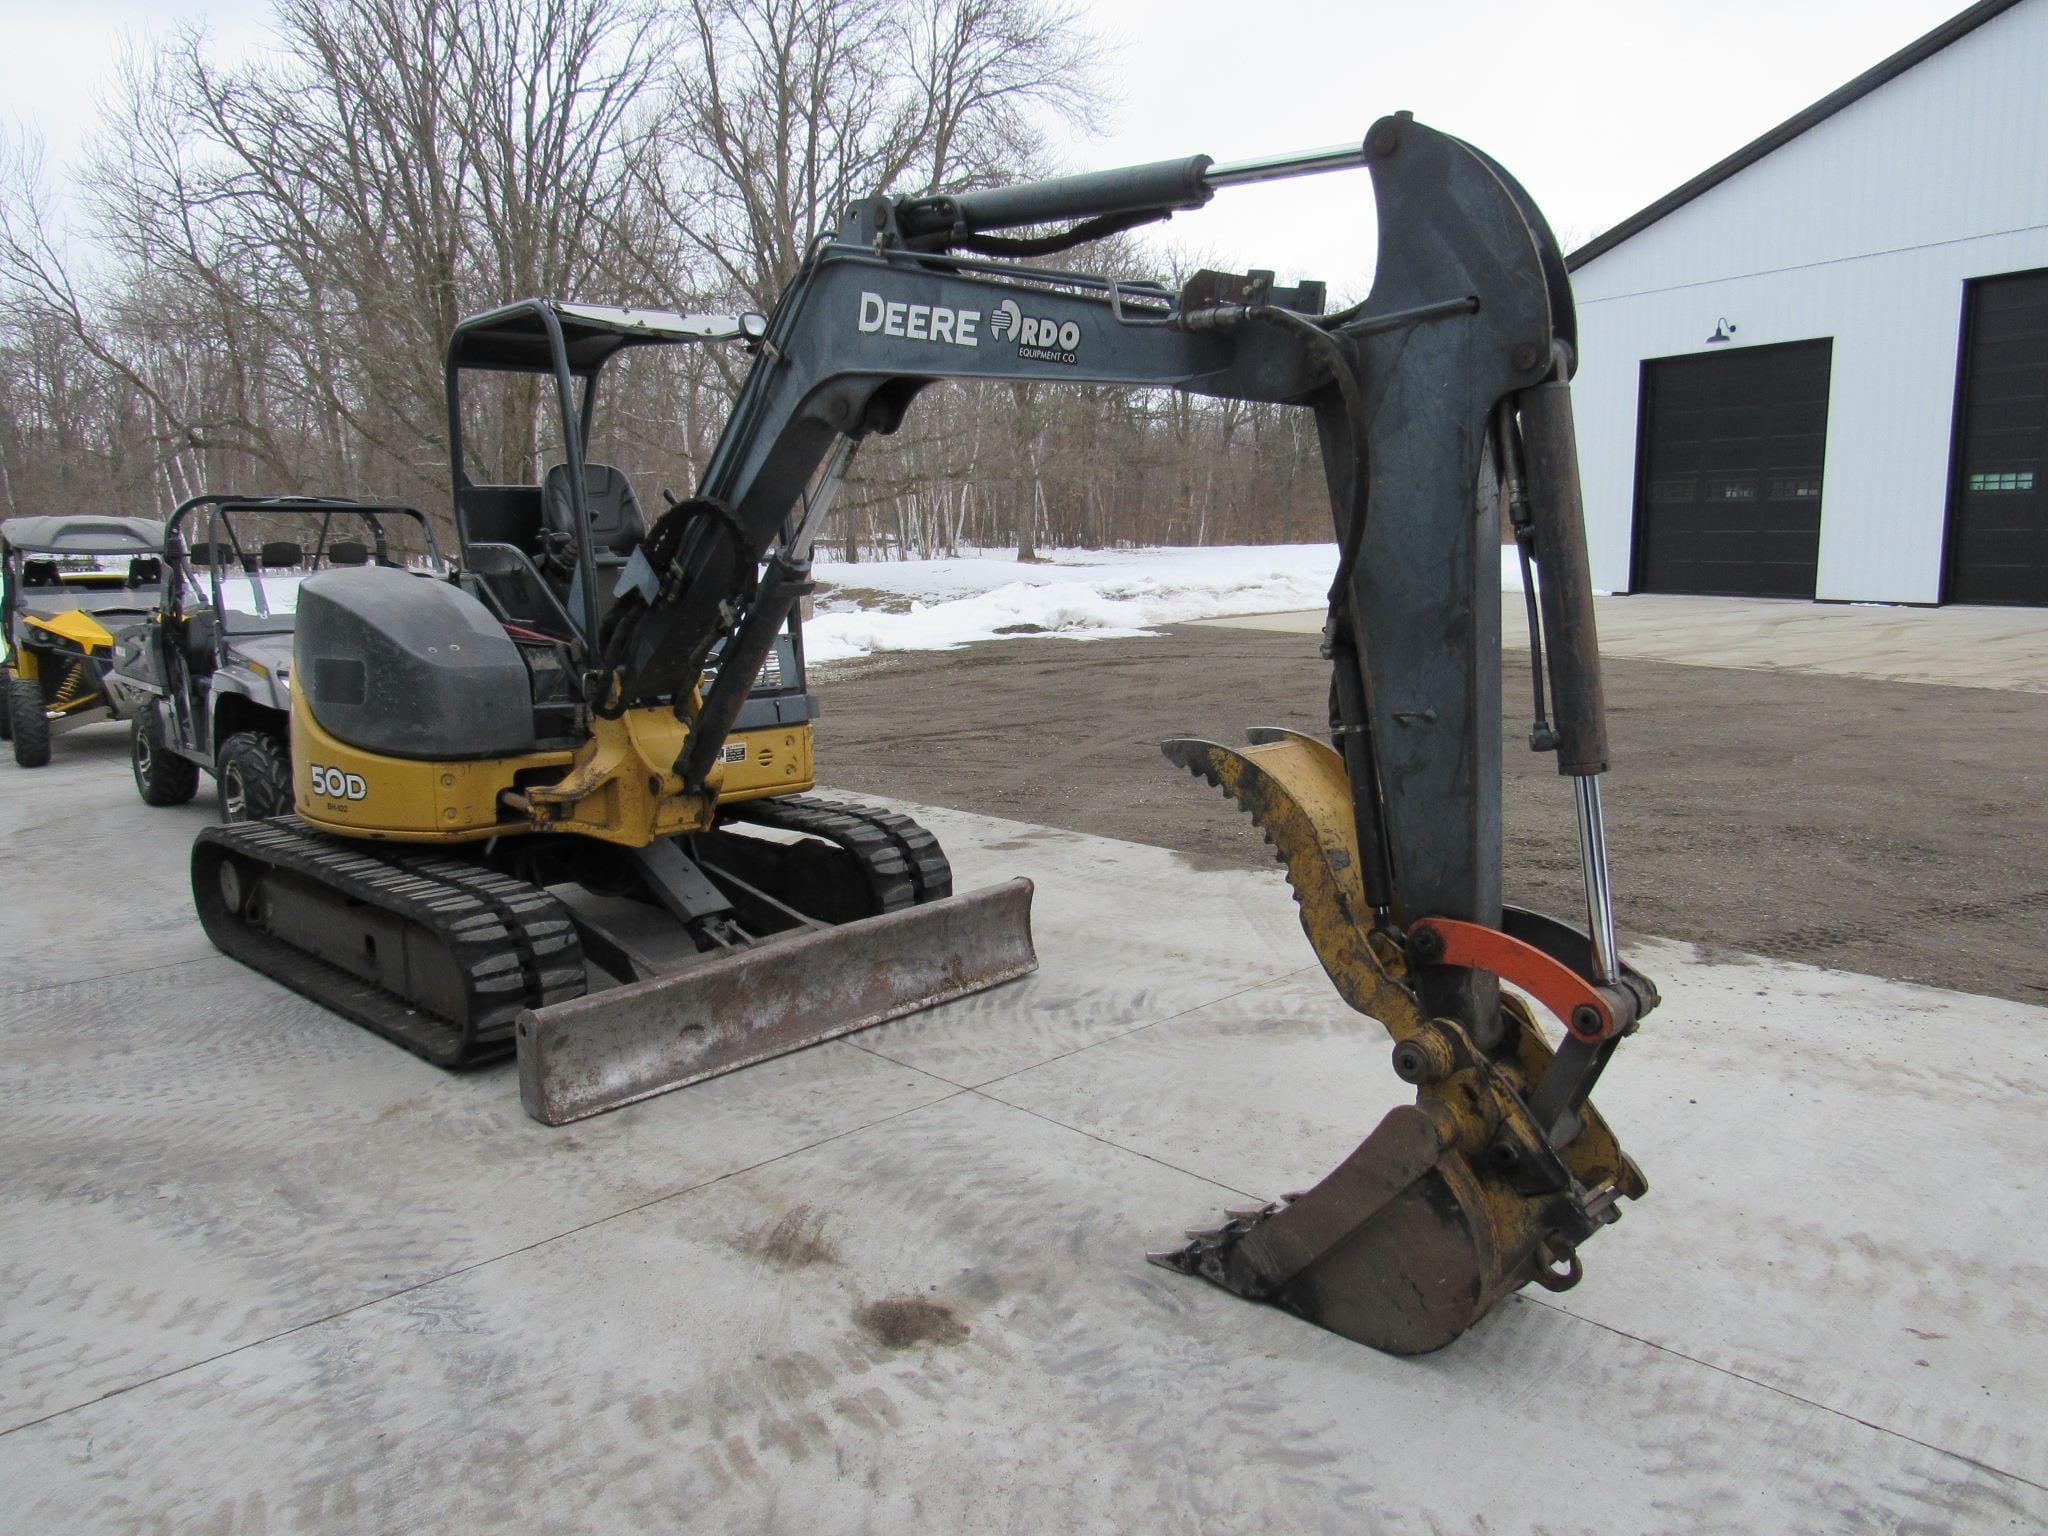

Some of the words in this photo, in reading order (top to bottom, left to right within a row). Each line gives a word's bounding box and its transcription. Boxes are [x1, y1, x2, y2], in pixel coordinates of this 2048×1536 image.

[858, 291, 981, 346] DEERE
[1019, 347, 1061, 362] EQUIPMENT
[311, 764, 367, 801] 50D
